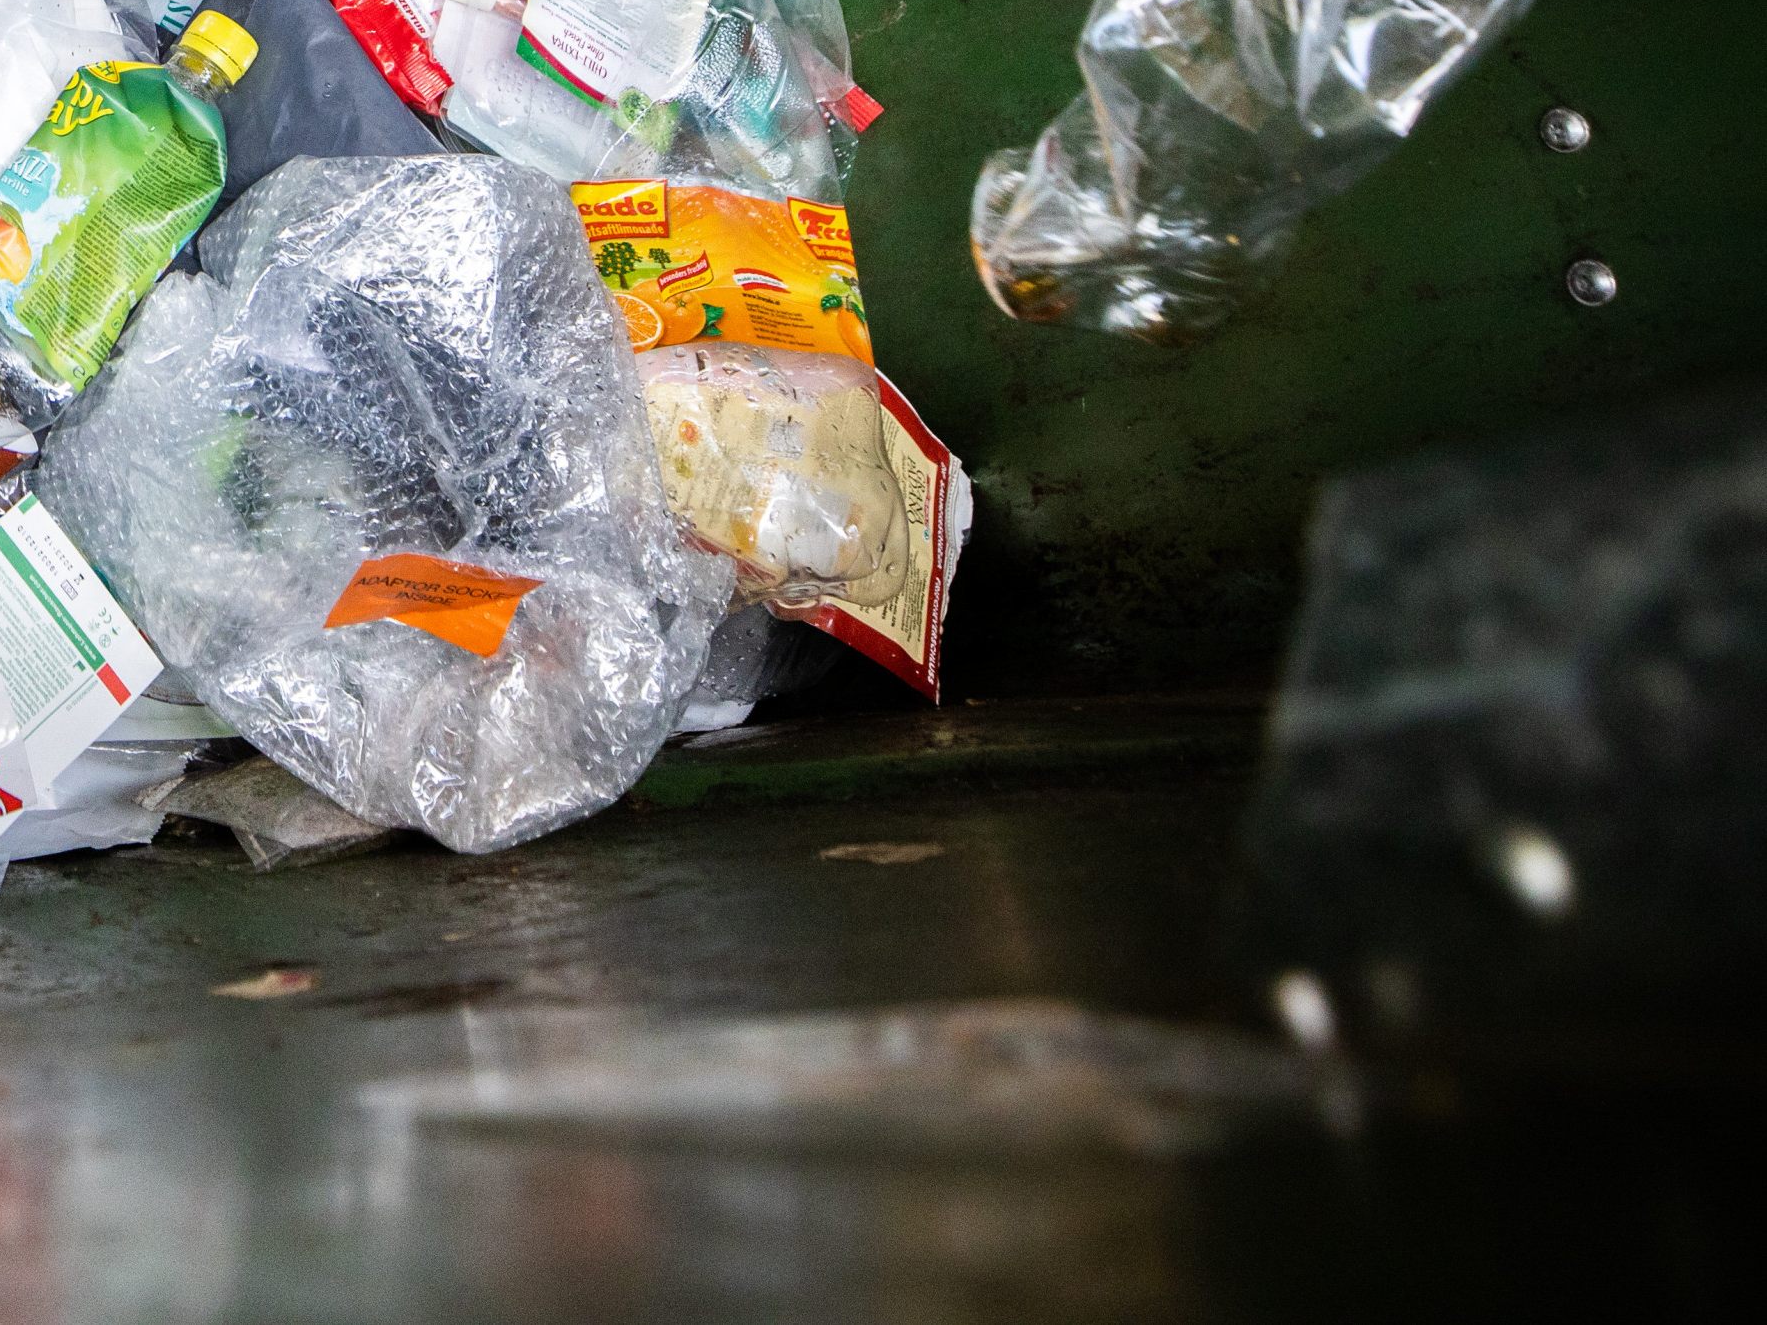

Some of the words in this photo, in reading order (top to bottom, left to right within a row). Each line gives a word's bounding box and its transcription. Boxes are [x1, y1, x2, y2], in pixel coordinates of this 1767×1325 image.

[560, 27, 588, 50] Fleisch
[584, 43, 606, 61] Ohne
[659, 268, 688, 285] besonders
[686, 259, 708, 275] fruchtig
[914, 470, 925, 525] GRANA
[357, 577, 440, 591] ADAPTOR
[395, 592, 457, 604] INSIDE
[927, 576, 941, 685] FRISCHEVERSCHLUSS
